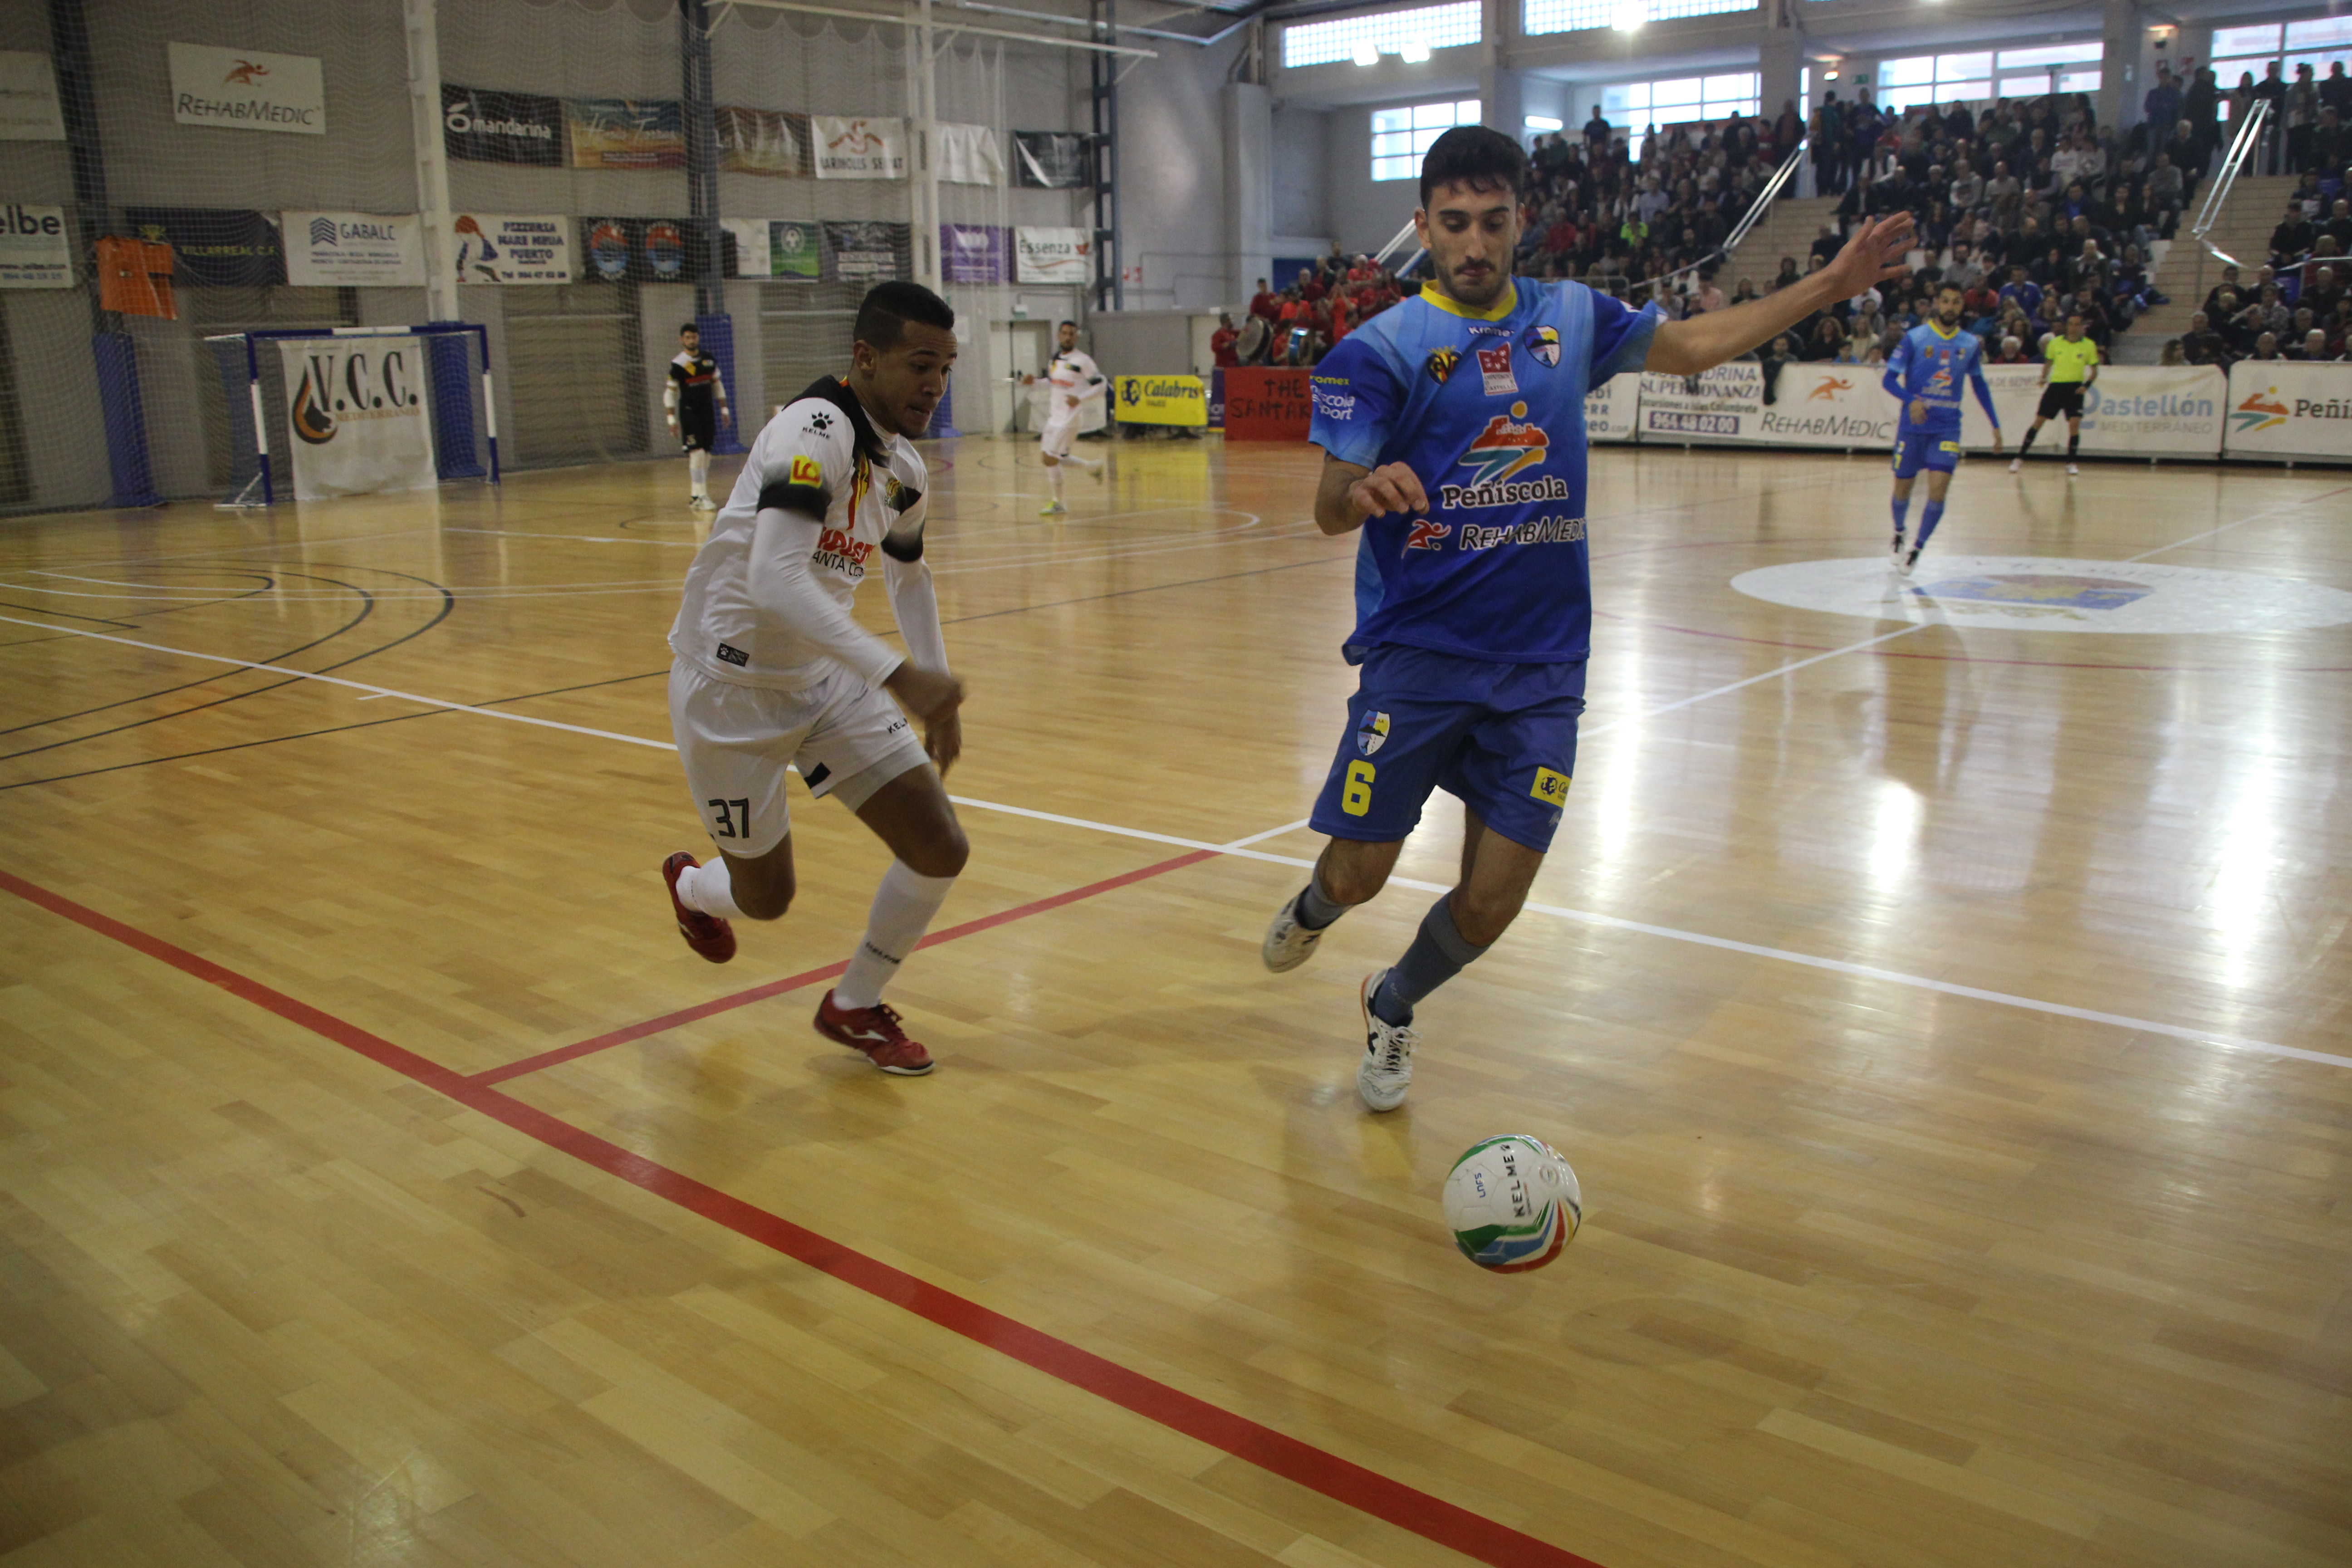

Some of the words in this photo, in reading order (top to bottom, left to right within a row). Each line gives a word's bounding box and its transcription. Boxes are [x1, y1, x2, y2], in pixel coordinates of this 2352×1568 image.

[472, 117, 552, 139] mandarina
[1019, 240, 1070, 255] Essenza
[1264, 378, 1305, 399] THE
[1309, 375, 1350, 385] romex
[2293, 398, 2352, 419] Peñí
[803, 426, 831, 440] KELME
[1441, 475, 1568, 509] Peñíscola
[812, 550, 845, 572] ANTA
[1342, 759, 1376, 817] 6
[708, 797, 749, 839] 37
[1475, 1172, 1486, 1198] LNFS
[1503, 1154, 1525, 1218] KELME
